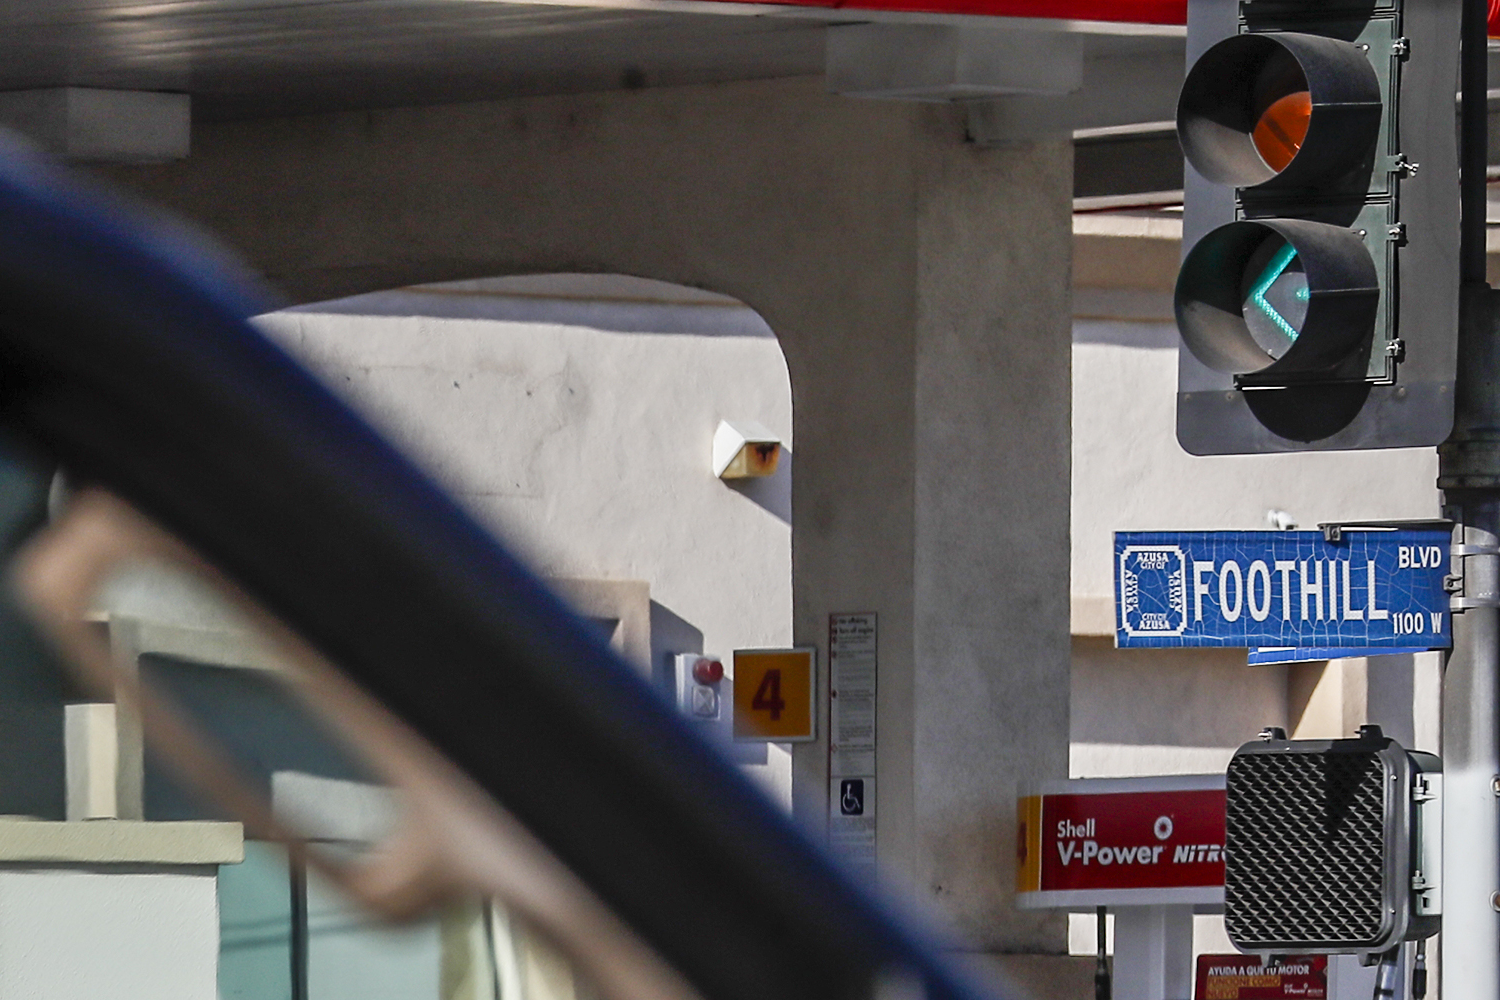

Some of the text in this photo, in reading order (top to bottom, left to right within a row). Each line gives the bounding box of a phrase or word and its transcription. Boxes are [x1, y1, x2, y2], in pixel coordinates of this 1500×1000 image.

[1137, 552, 1169, 562] AZUSA
[1140, 561, 1155, 569] CITY
[1399, 547, 1442, 568] BLVD
[1193, 560, 1388, 622] FOOTHILL
[1139, 620, 1170, 629] AZUSA
[1142, 613, 1157, 621] CITY
[1393, 613, 1443, 634] 1100 W
[752, 668, 785, 721] 4
[1057, 818, 1096, 838] Shell
[1057, 840, 1164, 866] V-Power
[1208, 966, 1237, 976] AYUDA
[1239, 966, 1245, 976] A
[1278, 965, 1310, 975] MOTOR
